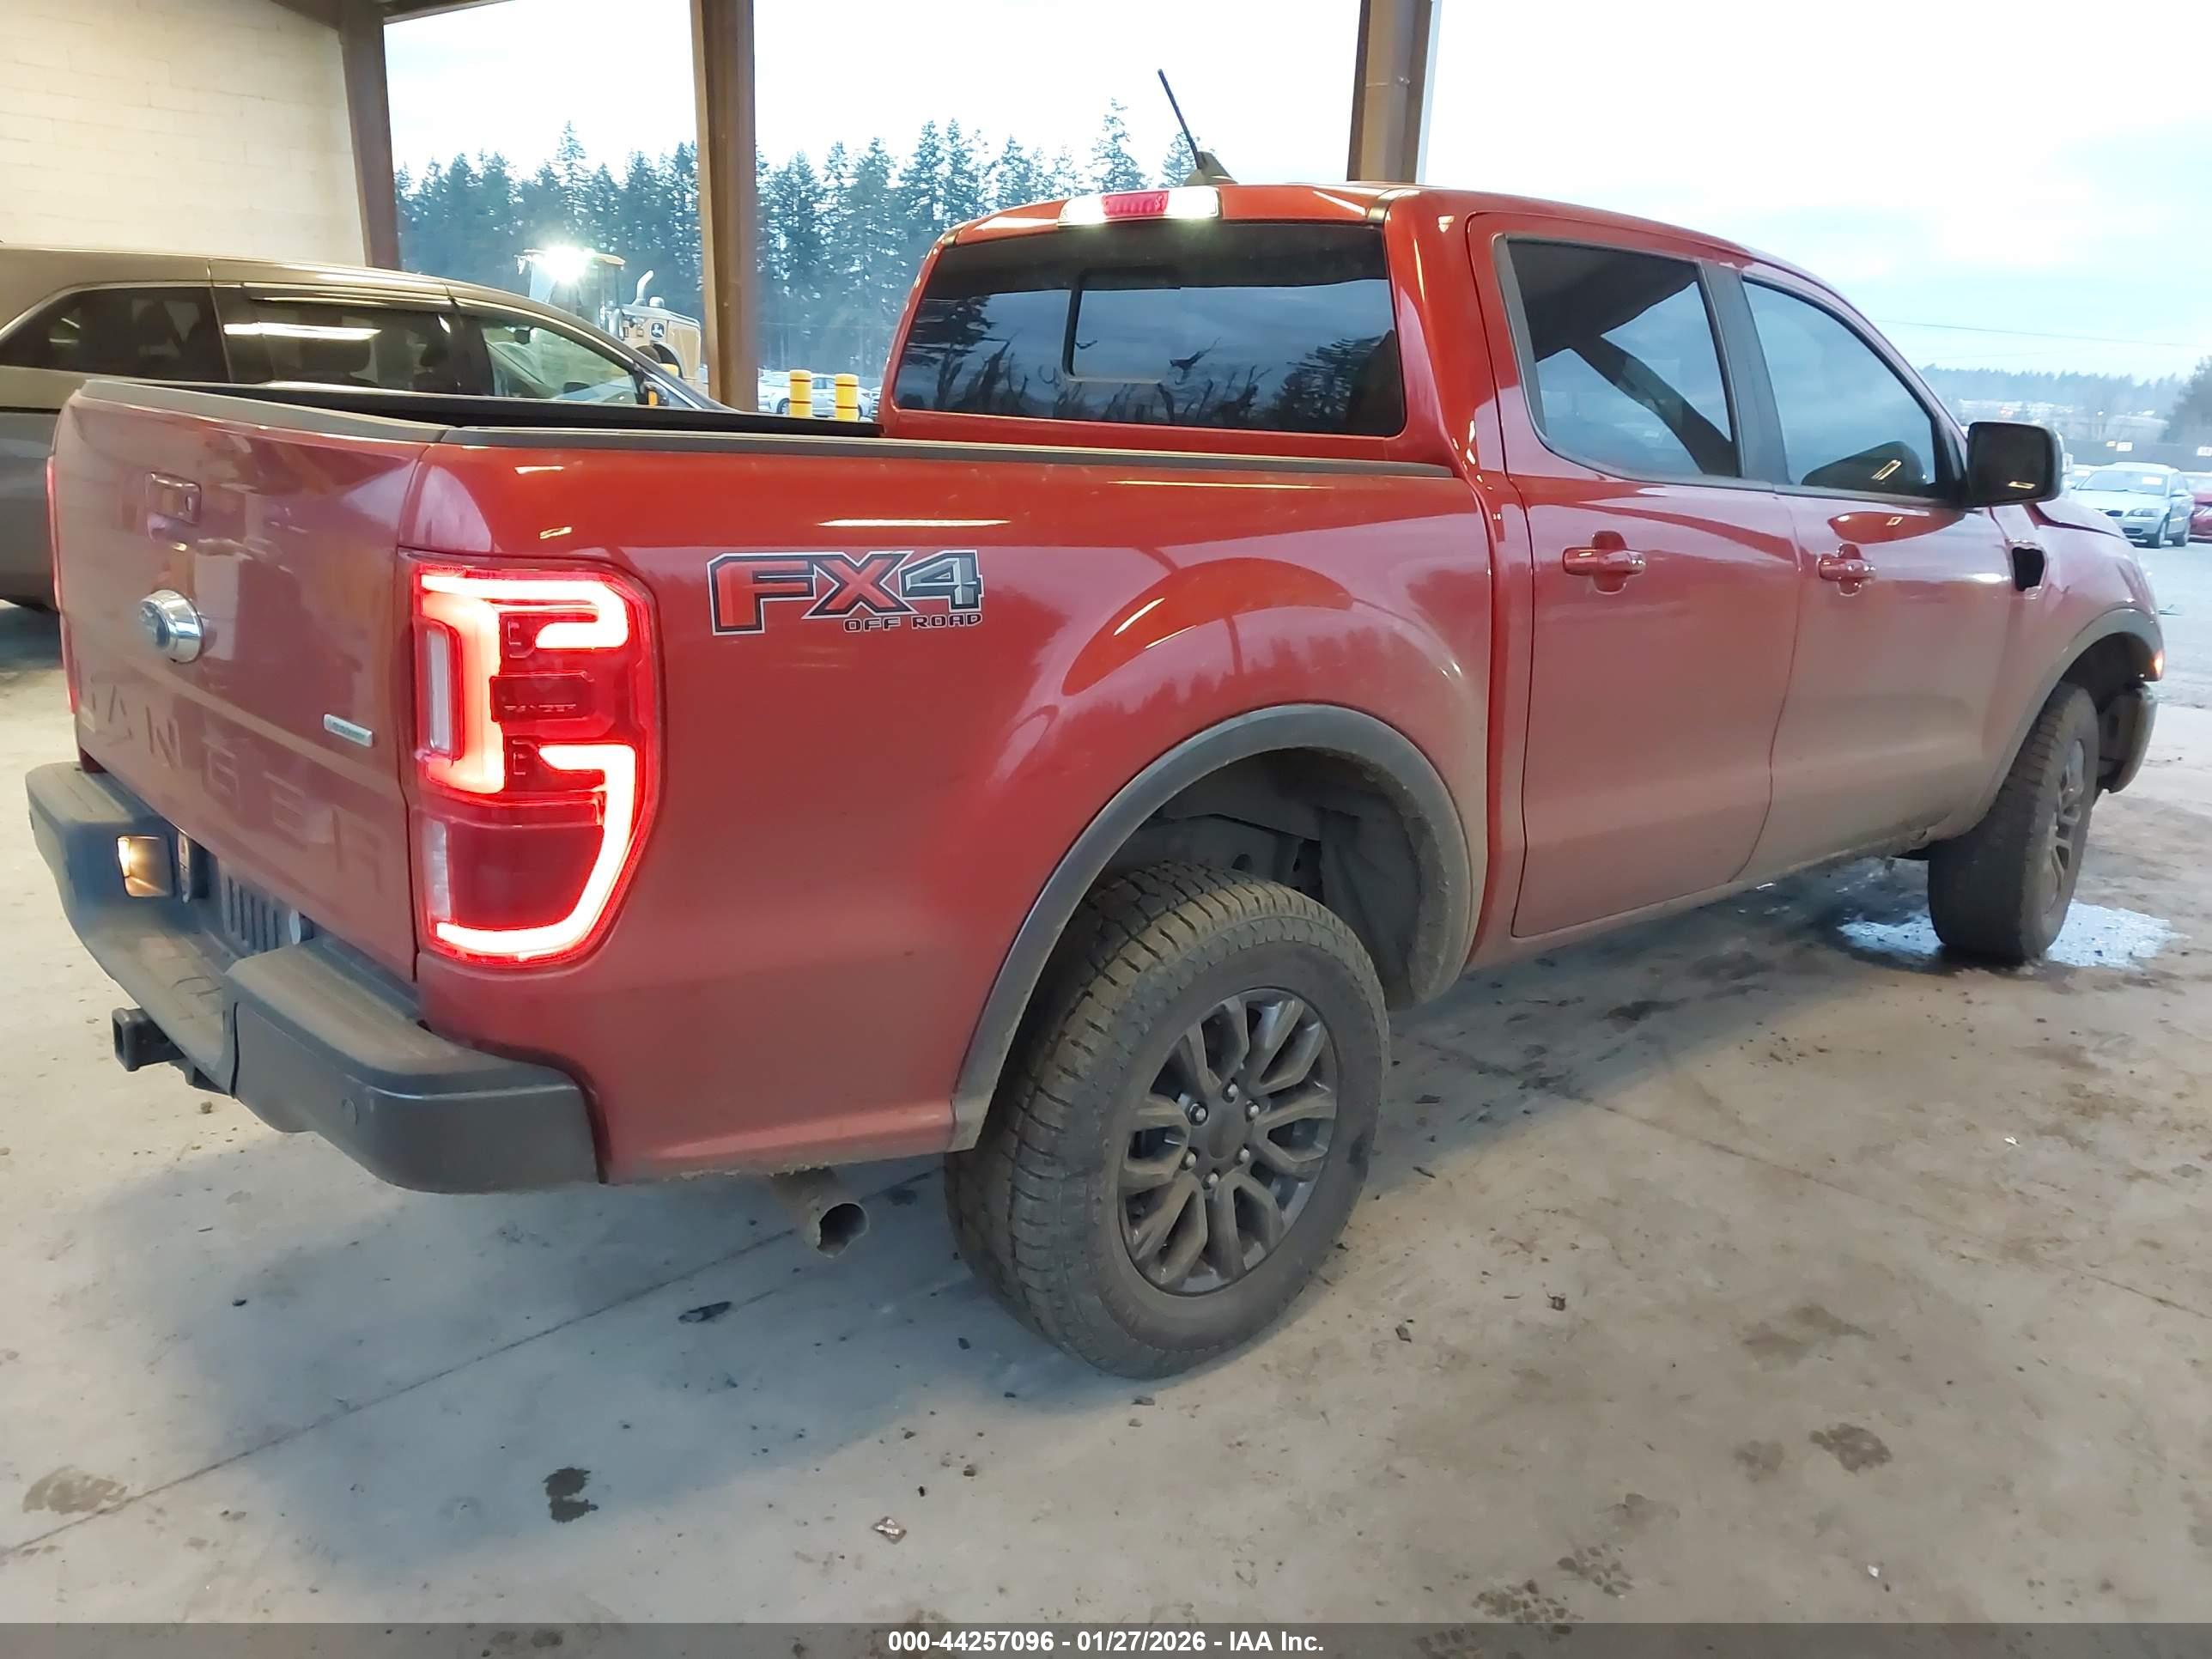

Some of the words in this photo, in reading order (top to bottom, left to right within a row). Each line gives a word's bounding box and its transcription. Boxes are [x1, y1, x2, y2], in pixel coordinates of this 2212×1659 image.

[707, 550, 984, 635] FX4
[843, 617, 901, 632] OFF
[912, 613, 982, 629] ROAD
